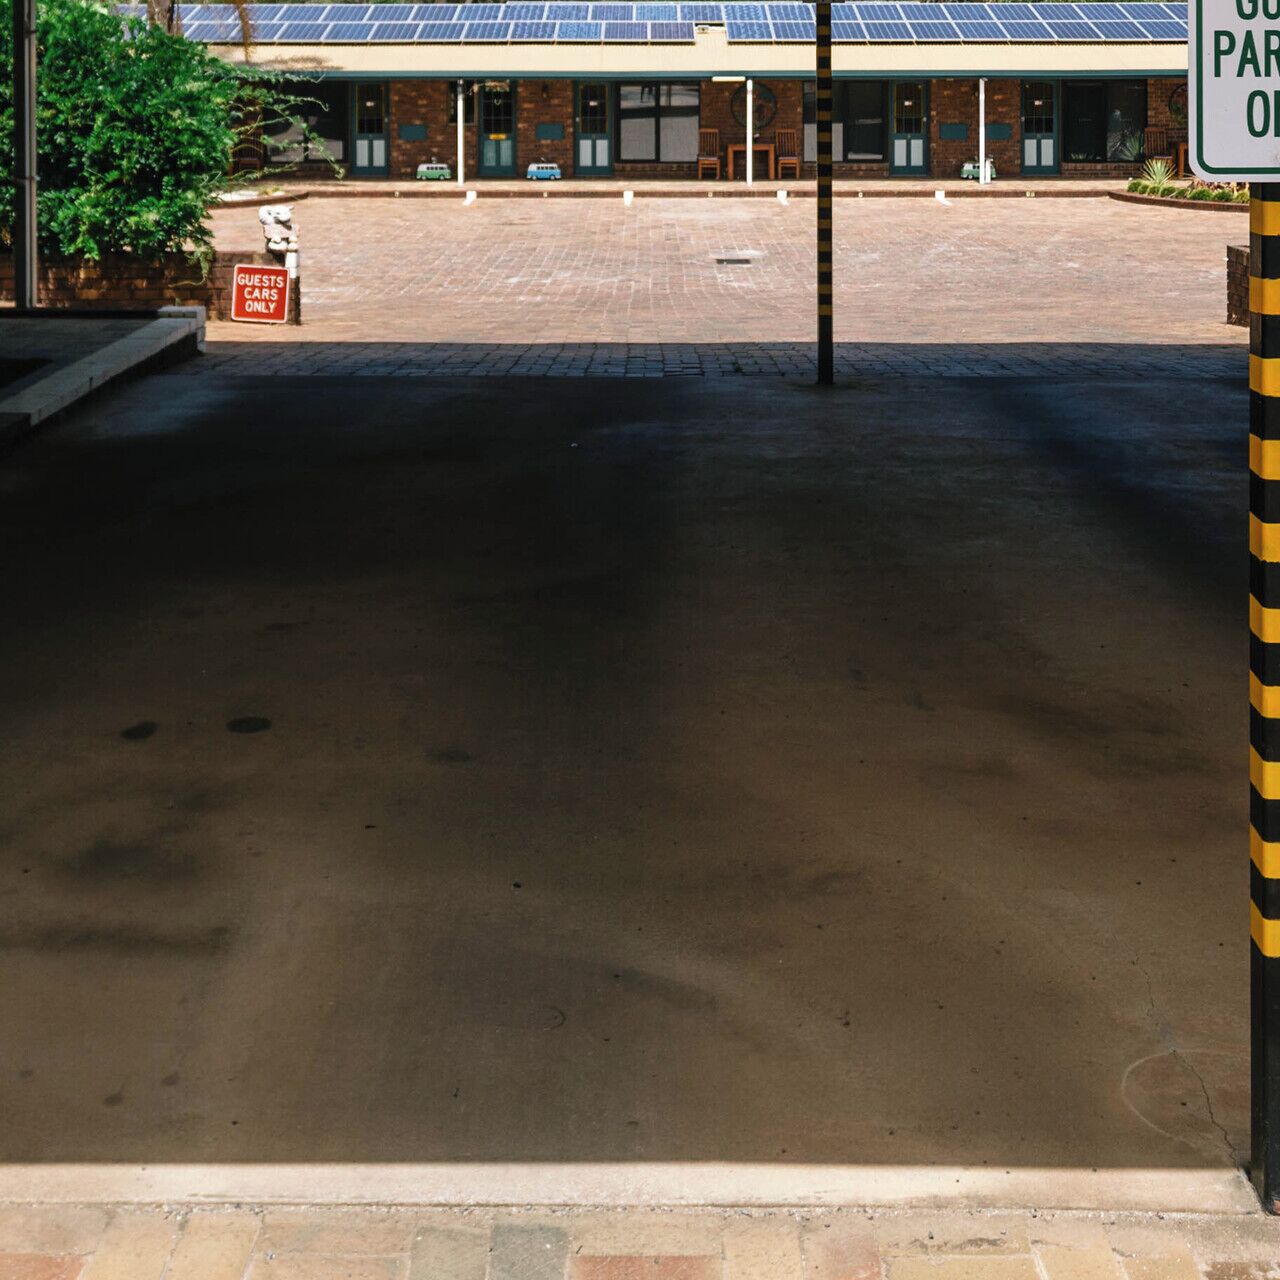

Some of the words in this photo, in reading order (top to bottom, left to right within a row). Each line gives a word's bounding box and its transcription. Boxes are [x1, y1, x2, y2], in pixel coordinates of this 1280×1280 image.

[237, 272, 284, 288] GUESTS
[244, 286, 279, 301] CARS
[245, 300, 276, 314] ONLY
